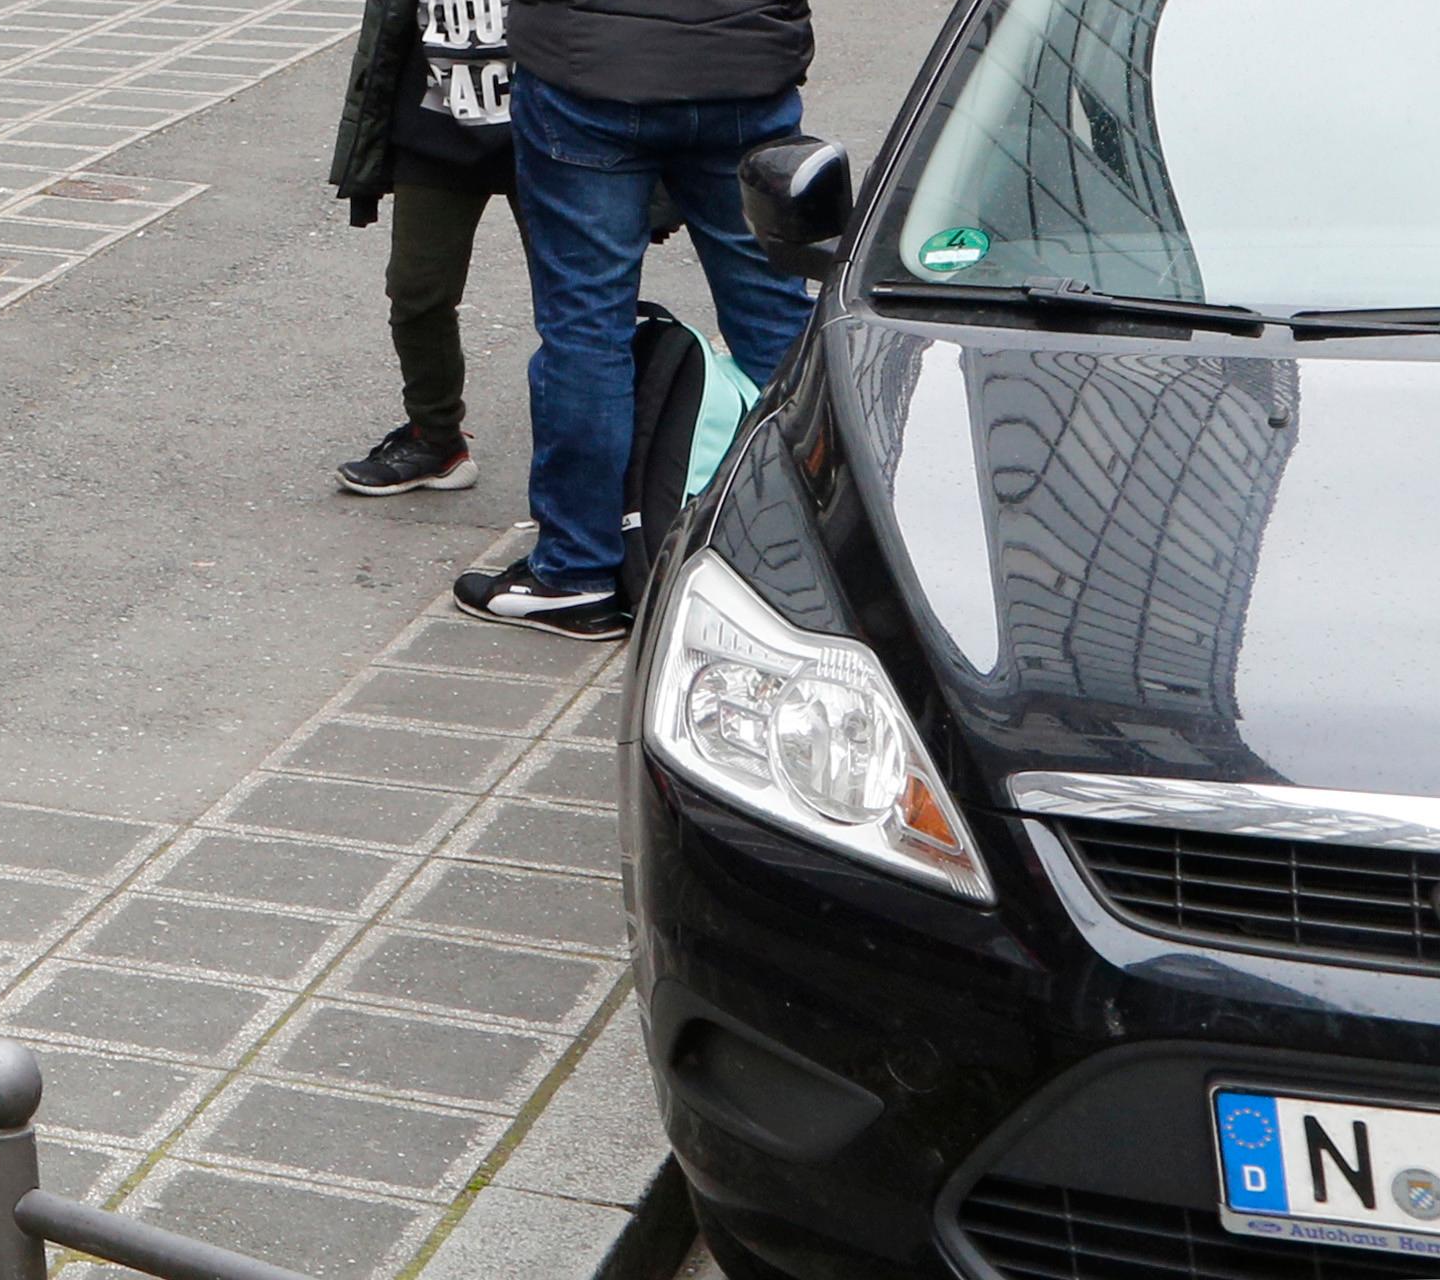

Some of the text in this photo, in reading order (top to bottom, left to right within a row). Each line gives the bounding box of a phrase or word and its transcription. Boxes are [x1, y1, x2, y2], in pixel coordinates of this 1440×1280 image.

[946, 229, 966, 249] 4
[1302, 1114, 1377, 1210] N
[1242, 1164, 1268, 1194] D
[1290, 1223, 1389, 1248] Autohaus
